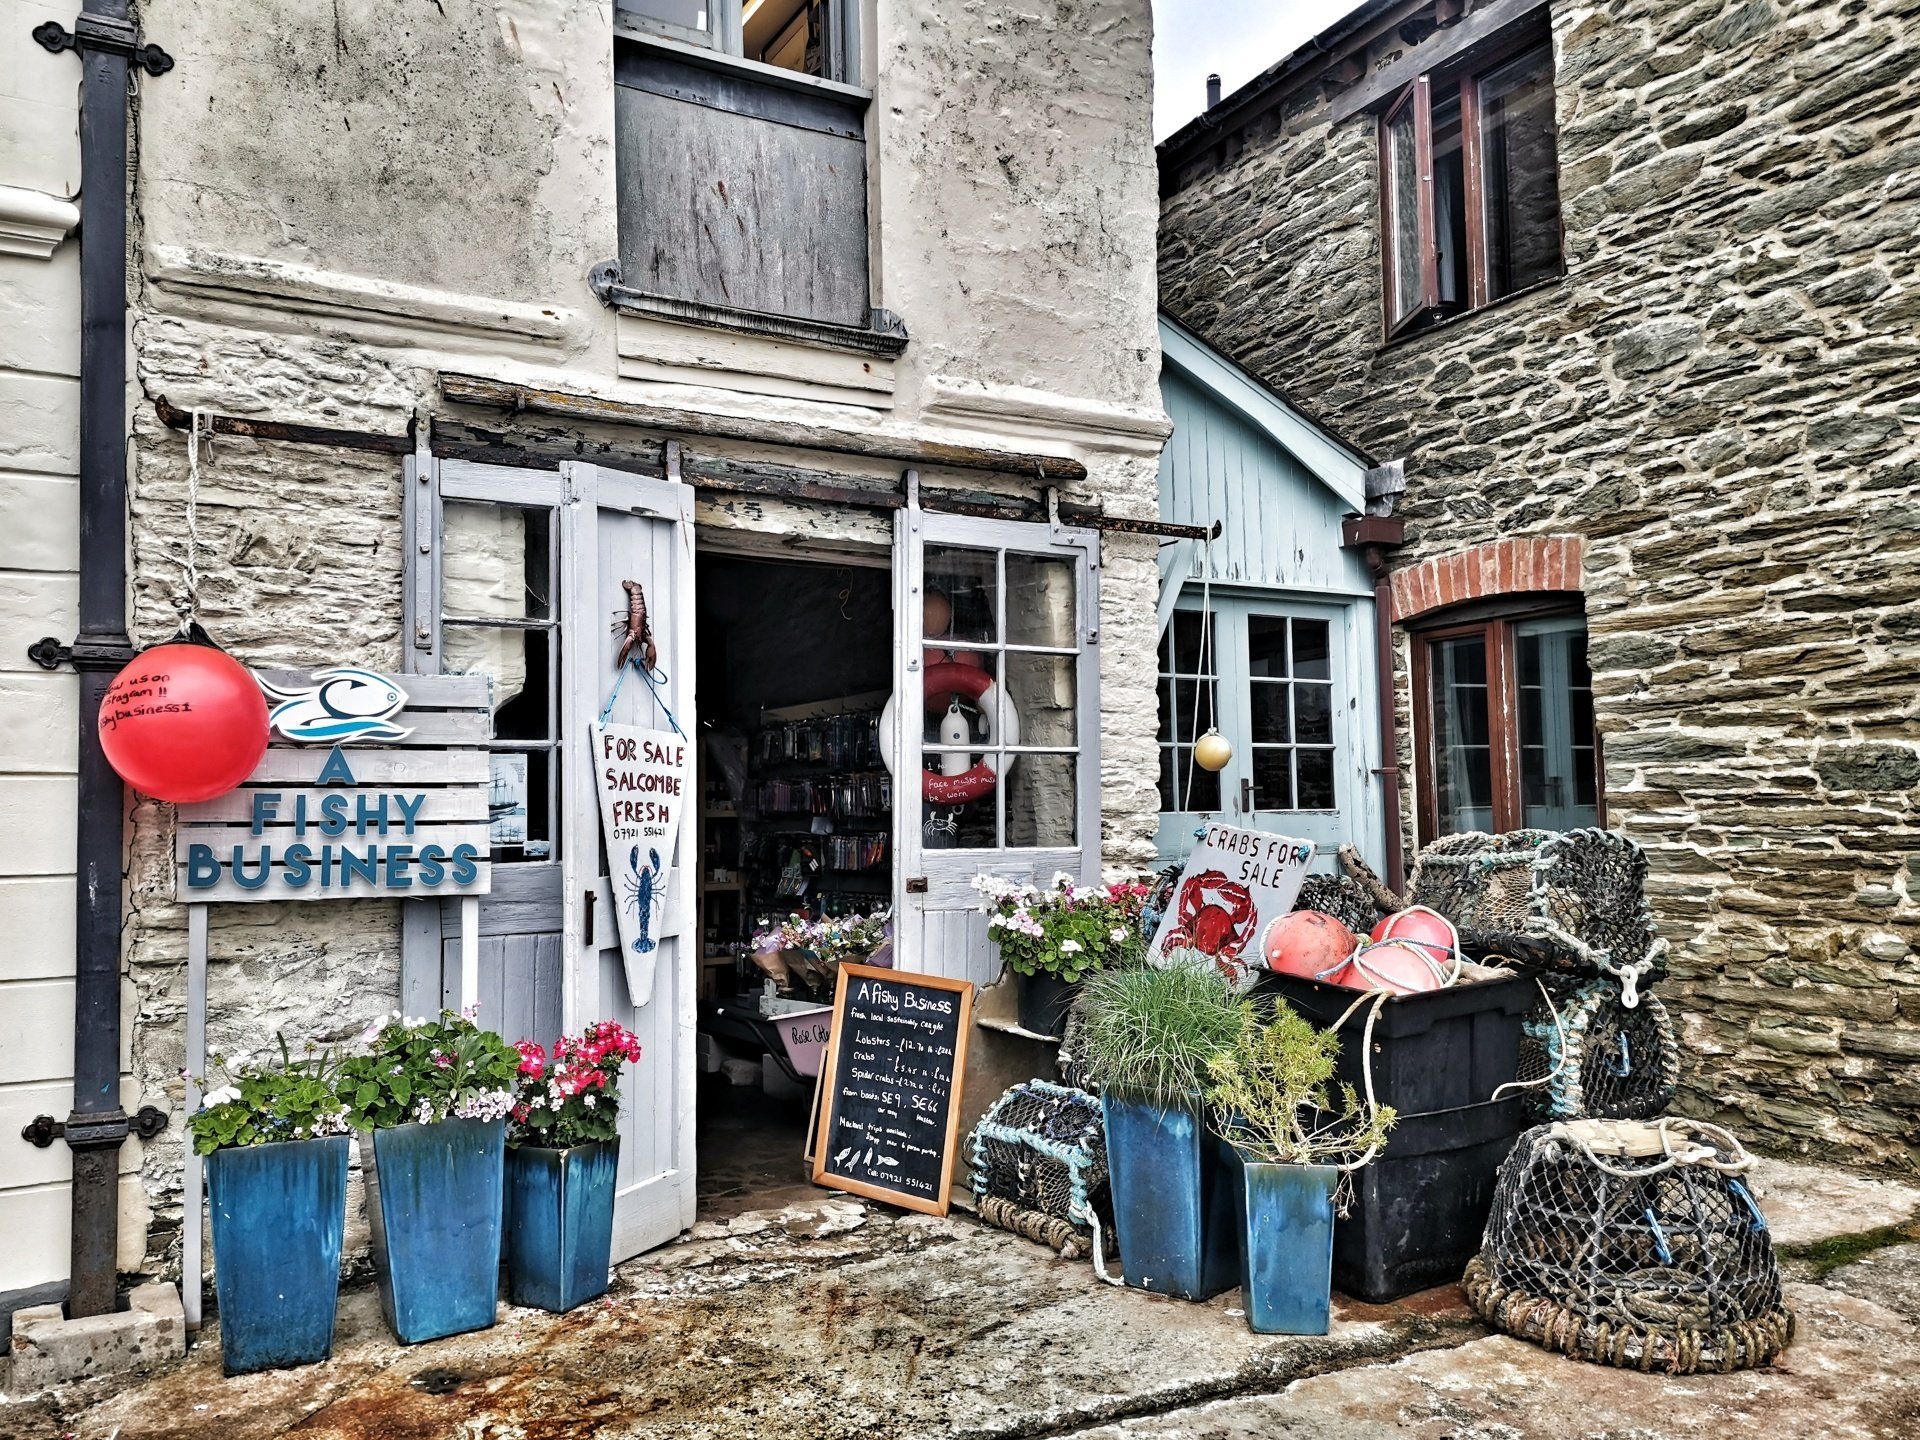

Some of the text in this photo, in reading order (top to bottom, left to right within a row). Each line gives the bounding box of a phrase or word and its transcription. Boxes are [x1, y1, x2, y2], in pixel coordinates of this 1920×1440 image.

[314, 744, 358, 786] A
[604, 735, 684, 767] FOR SALE
[605, 767, 682, 796] SALCOMBE
[928, 792, 939, 802] be
[251, 793, 427, 837] FISHY
[612, 800, 669, 827] FRESH
[613, 826, 666, 840] 07921 551421
[1206, 827, 1301, 867] CRABS FOR
[187, 843, 479, 889] BUSINESS
[1238, 860, 1284, 889] SALE
[857, 982, 870, 1001] A
[903, 991, 952, 1015] Business
[870, 1012, 884, 1022] local
[791, 1026, 812, 1045] Rose
[880, 1172, 903, 1184] 07921
[905, 1177, 933, 1191] 551421
